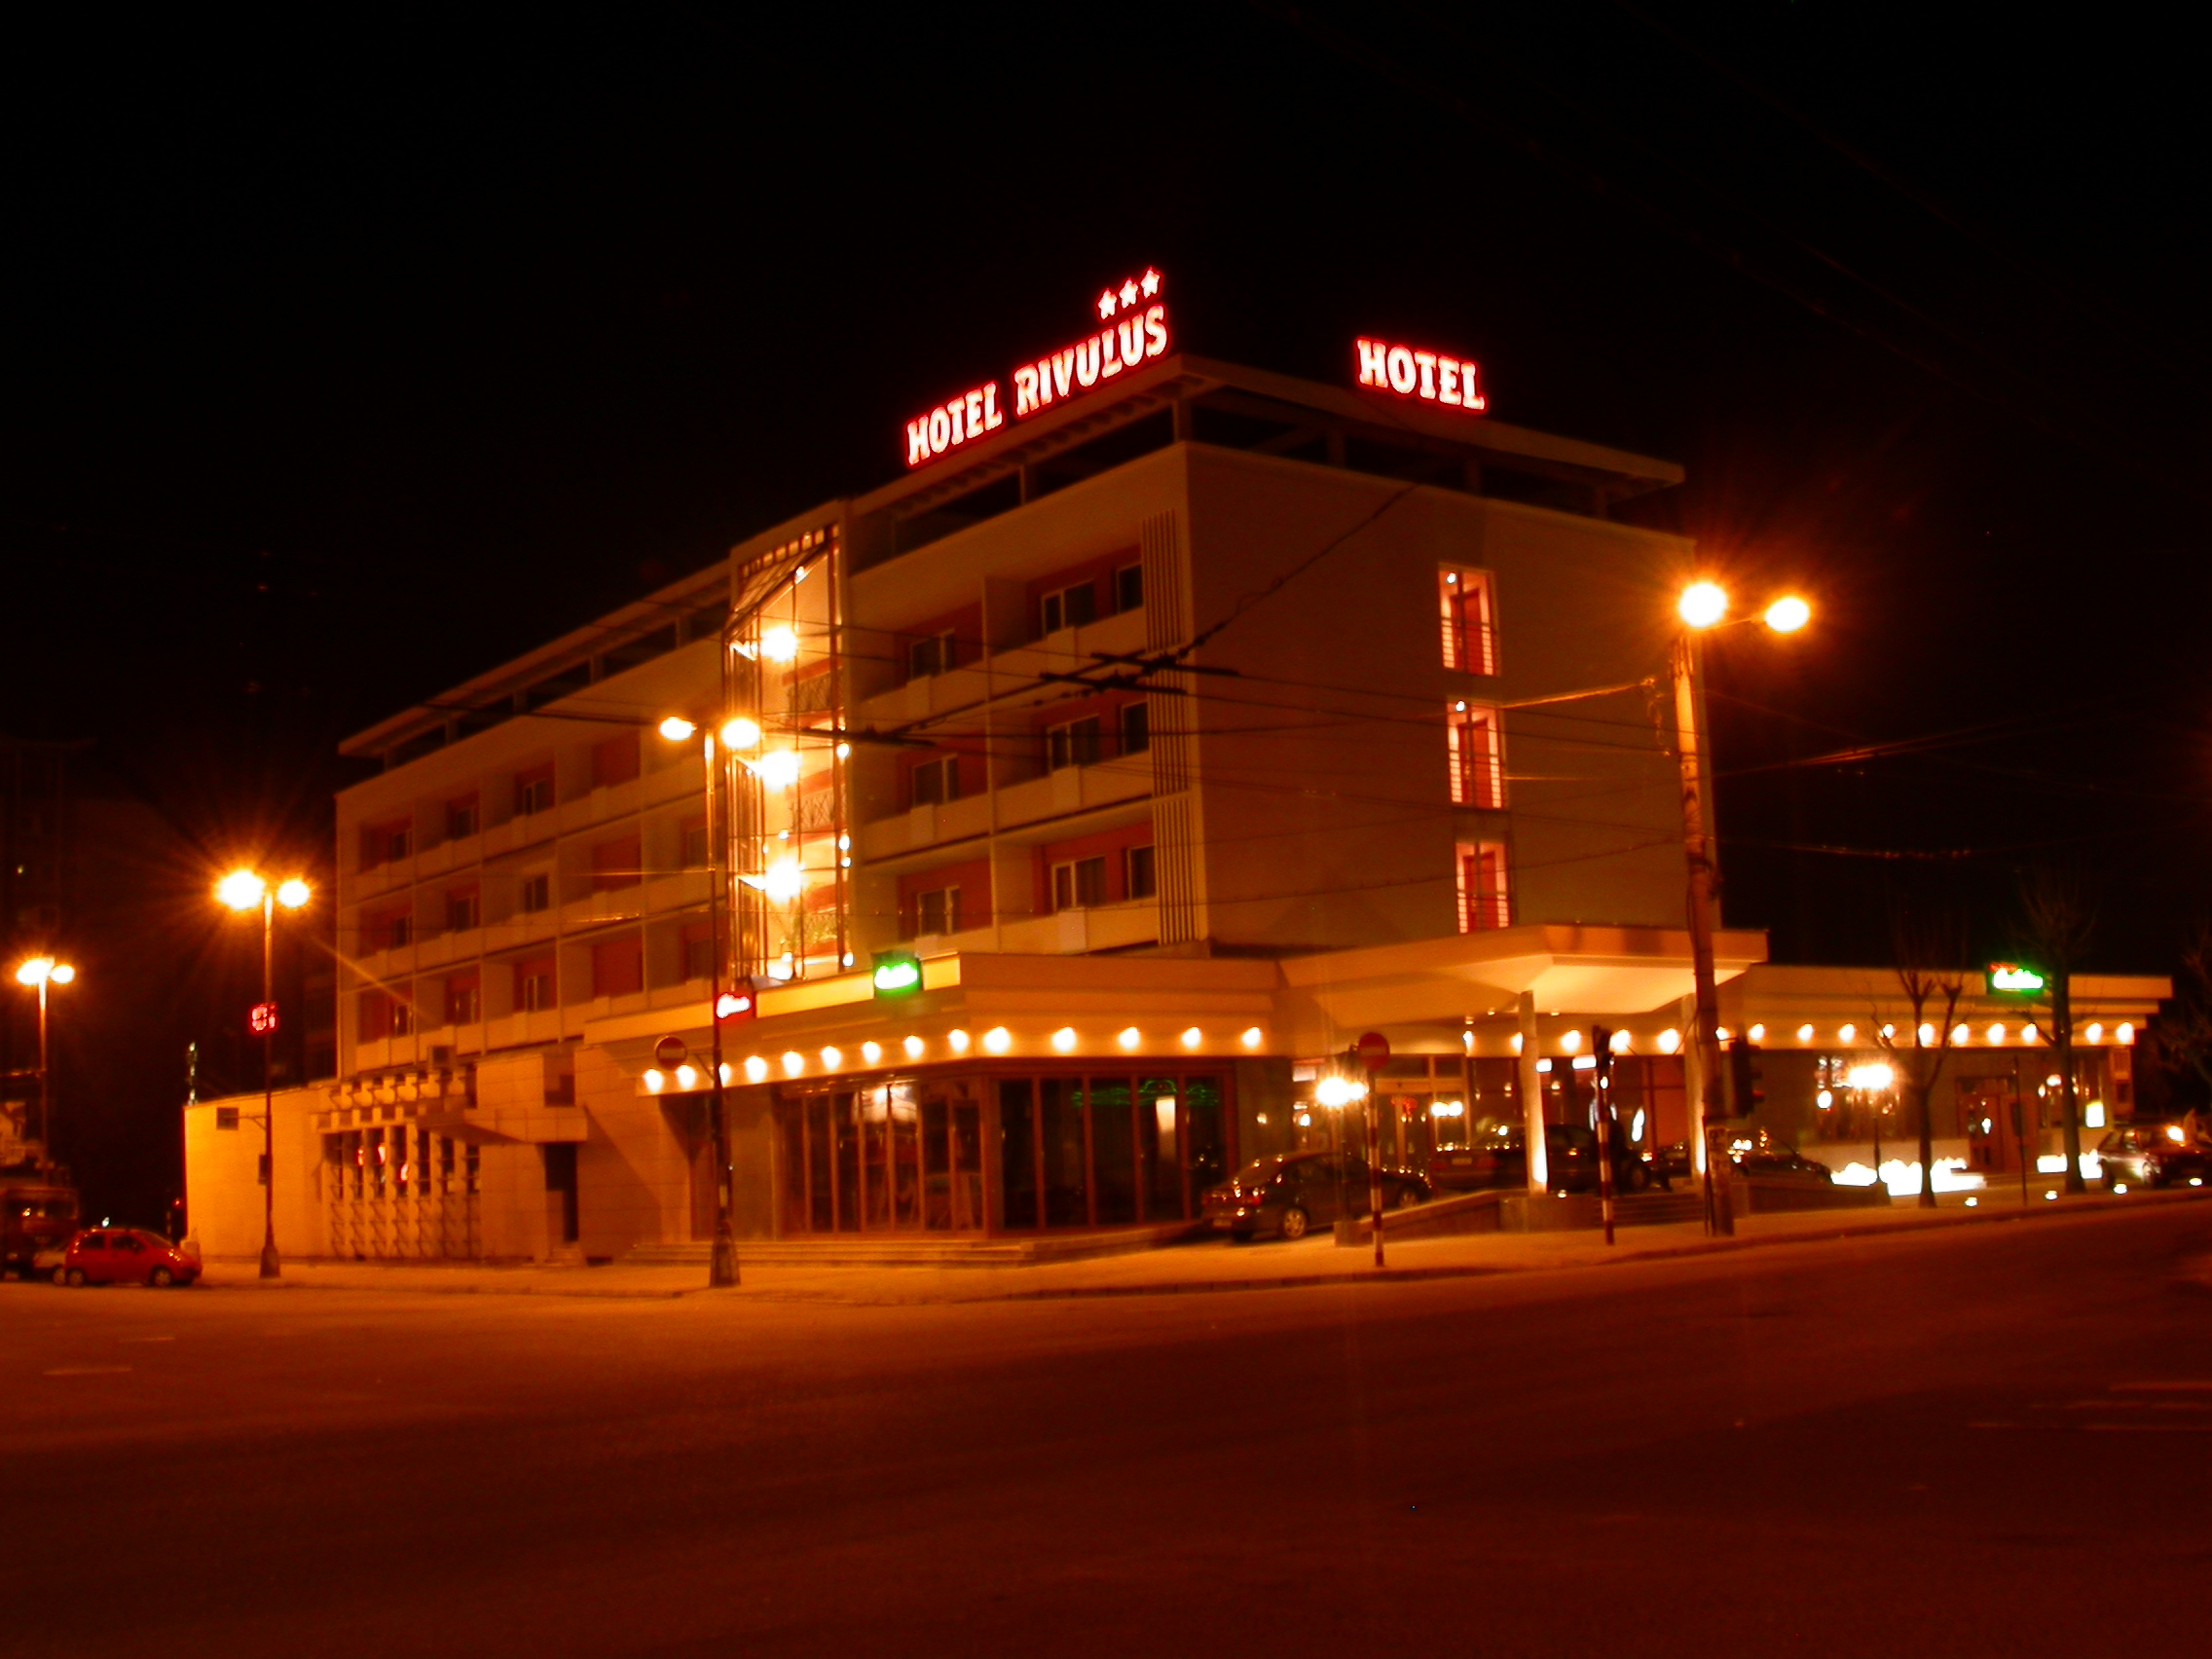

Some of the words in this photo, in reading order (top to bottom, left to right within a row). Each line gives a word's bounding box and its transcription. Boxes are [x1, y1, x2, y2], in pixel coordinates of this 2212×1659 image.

[906, 383, 1002, 464] HOTEL
[1014, 304, 1167, 416] RIVULUS
[1357, 339, 1485, 411] HOTEL
